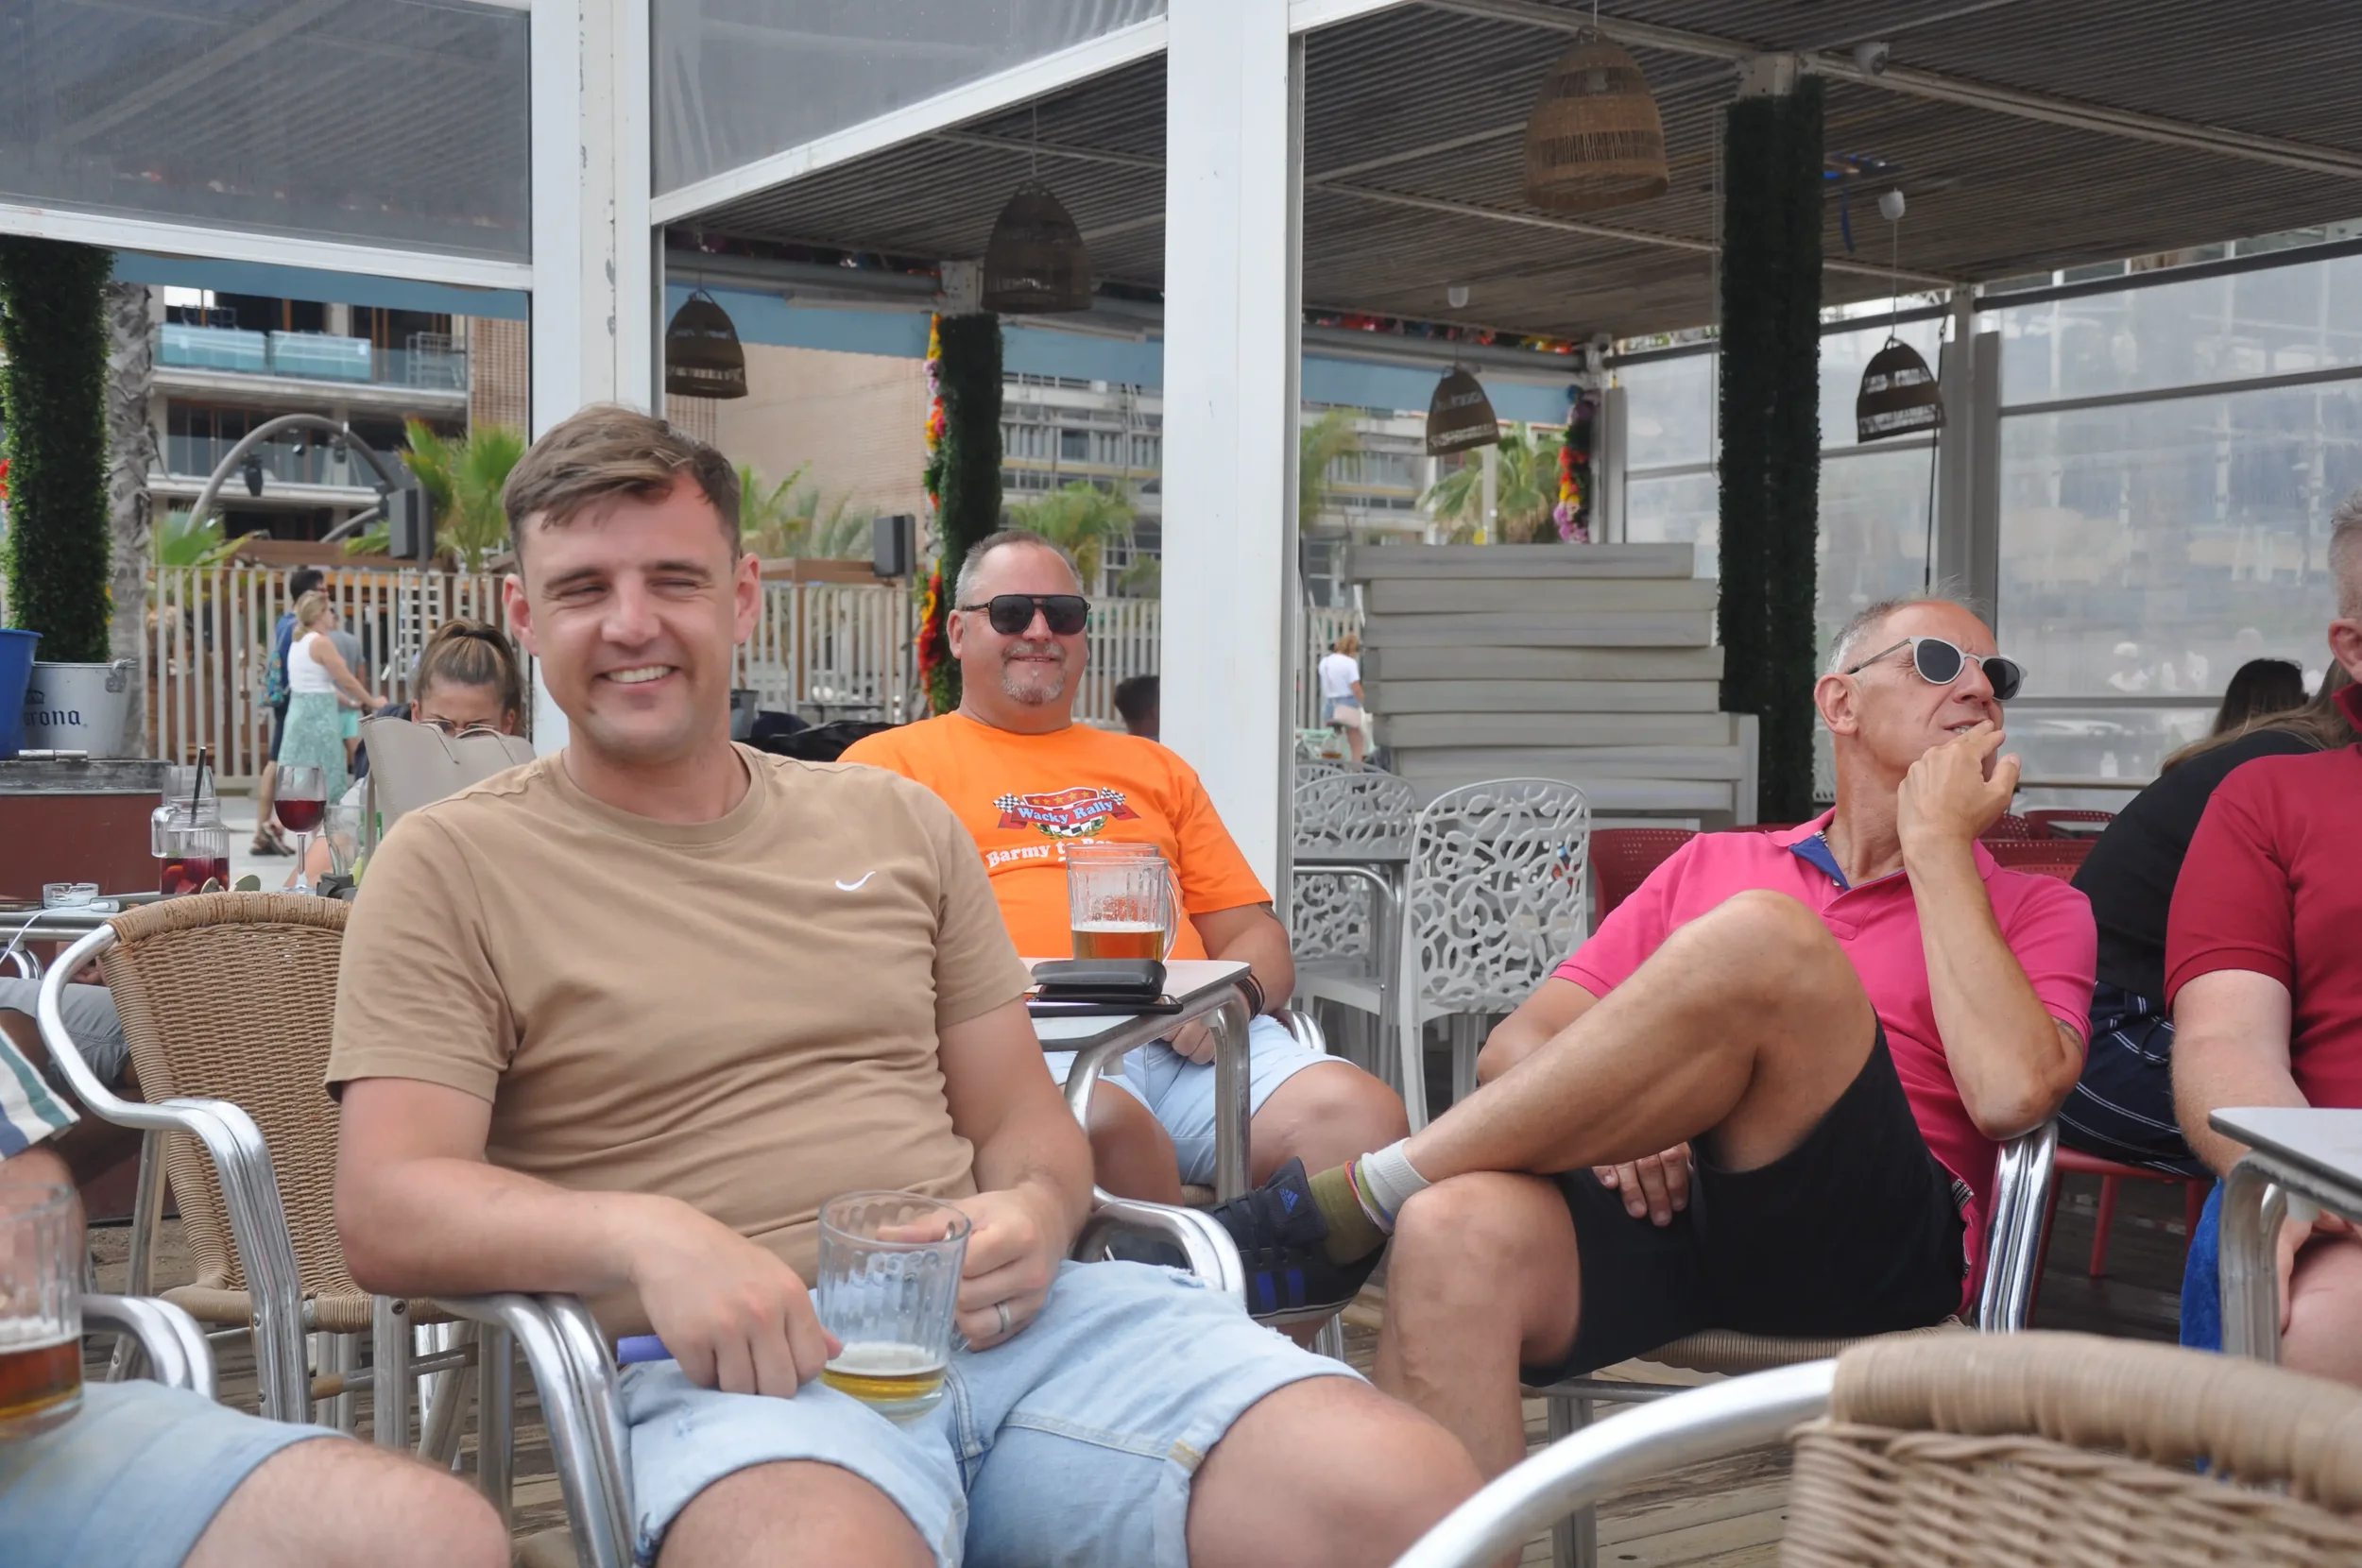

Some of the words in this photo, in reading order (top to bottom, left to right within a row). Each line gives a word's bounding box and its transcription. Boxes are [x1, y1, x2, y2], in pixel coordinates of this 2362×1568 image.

[24, 710, 81, 726] orona
[1018, 807, 1069, 825] Wacky
[1073, 801, 1114, 820] Rally
[985, 844, 1051, 868] Barmy
